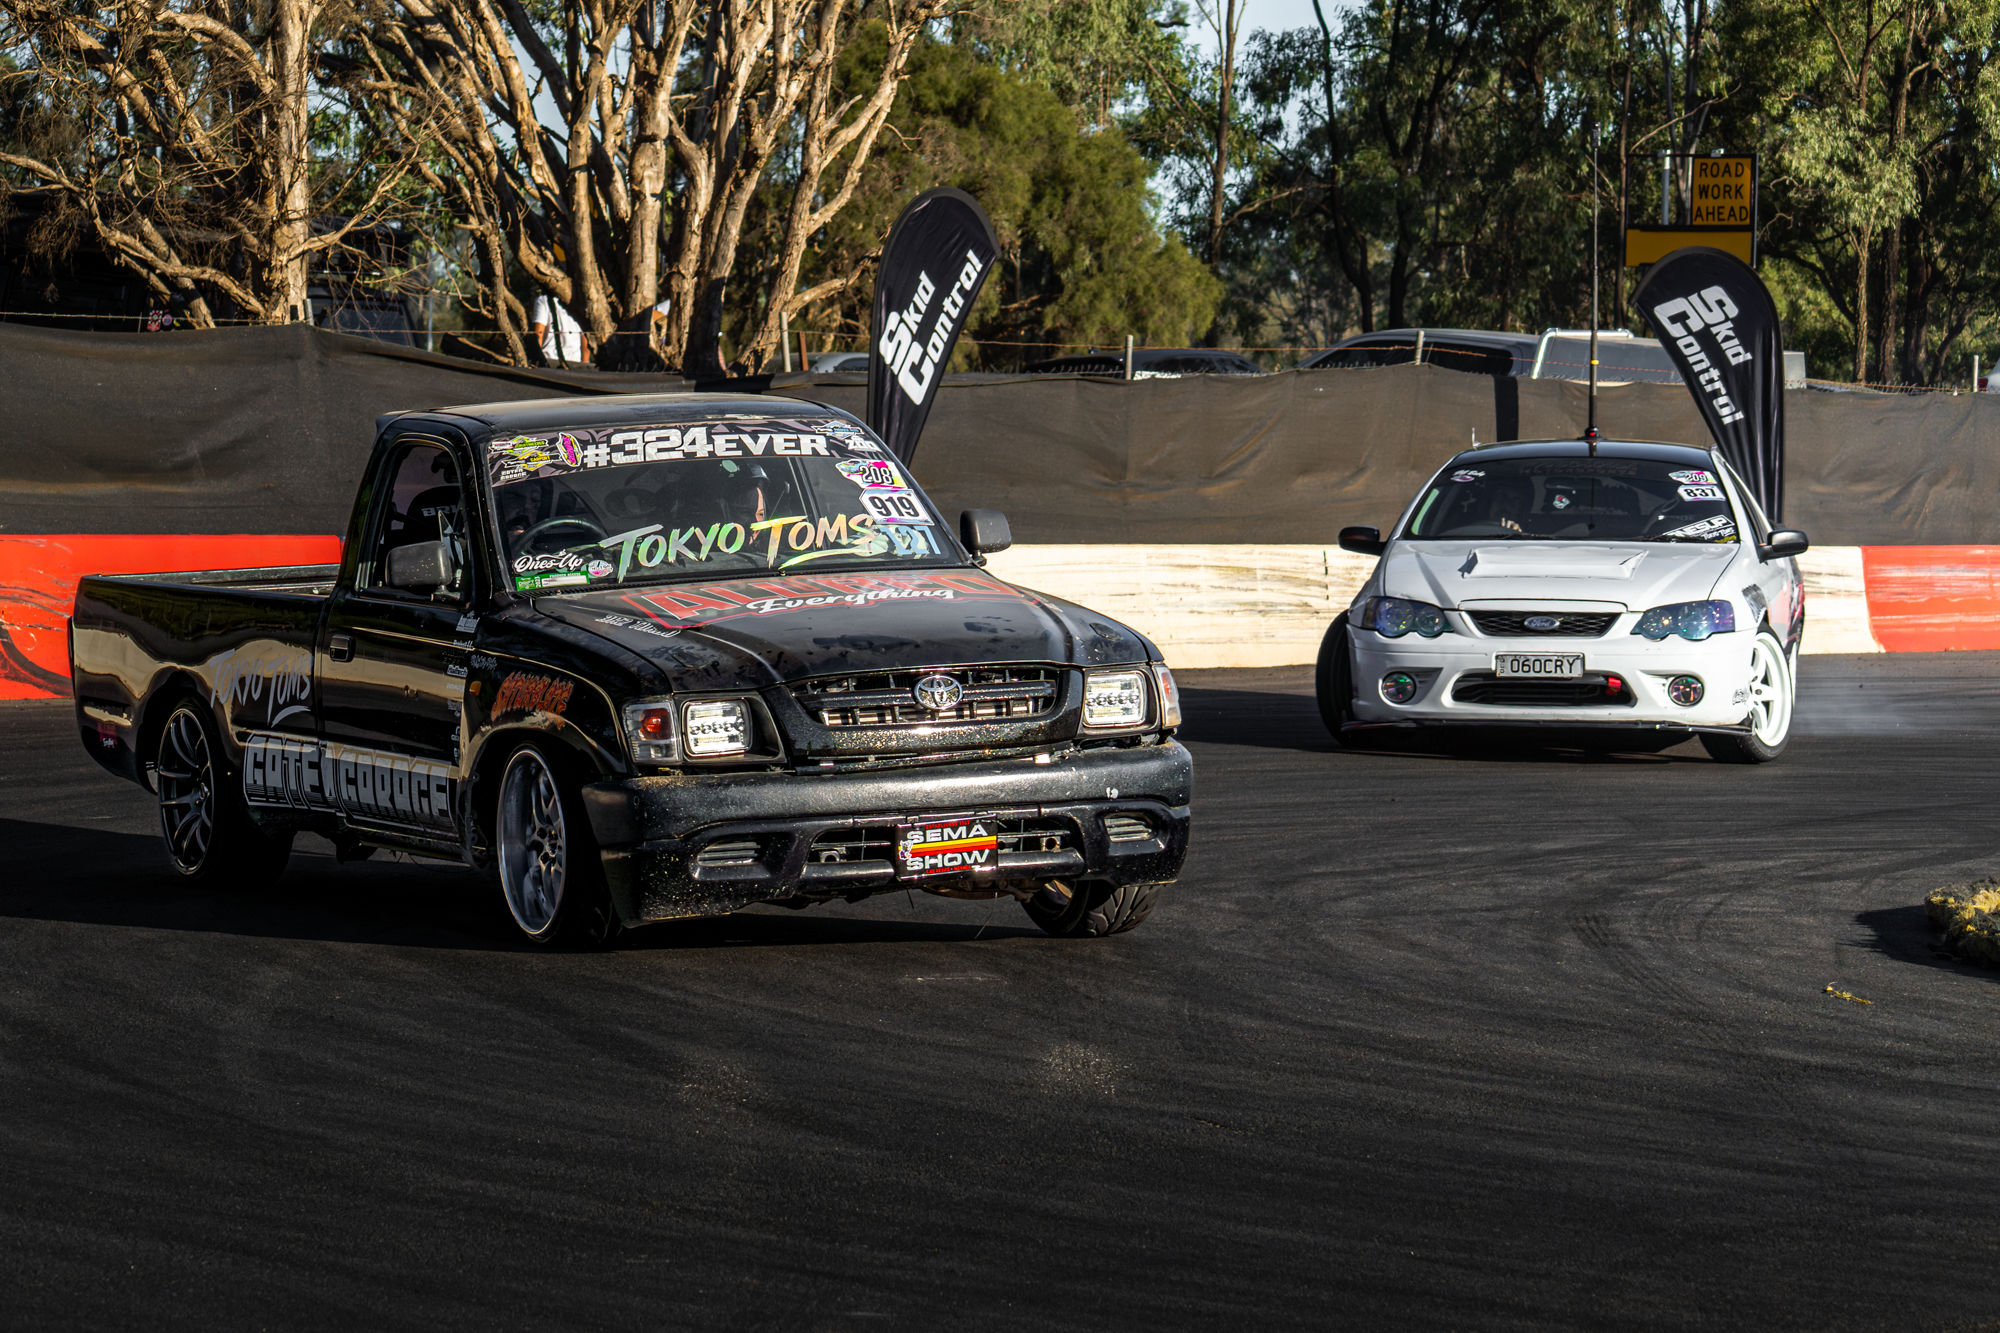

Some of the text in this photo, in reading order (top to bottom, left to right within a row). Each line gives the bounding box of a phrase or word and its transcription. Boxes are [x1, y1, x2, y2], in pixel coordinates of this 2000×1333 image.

[1700, 162, 1745, 178] ROAD
[1699, 184, 1744, 200] WORK
[1694, 206, 1749, 222] AHEAD
[879, 270, 936, 375] Skid
[898, 249, 983, 405] Control
[1688, 285, 1753, 366] Skid
[1653, 297, 1745, 425] Control
[584, 427, 831, 468] #324EVER
[860, 466, 893, 484] 208
[1684, 487, 1717, 497] 837
[868, 496, 920, 517] 919
[598, 513, 876, 583] TOKYO TOMS
[746, 586, 954, 614] Everything
[1531, 618, 1551, 627] Ford
[209, 649, 314, 725] TOKYO TOMS
[907, 824, 988, 844] SEMA
[906, 849, 989, 871] SHOW
